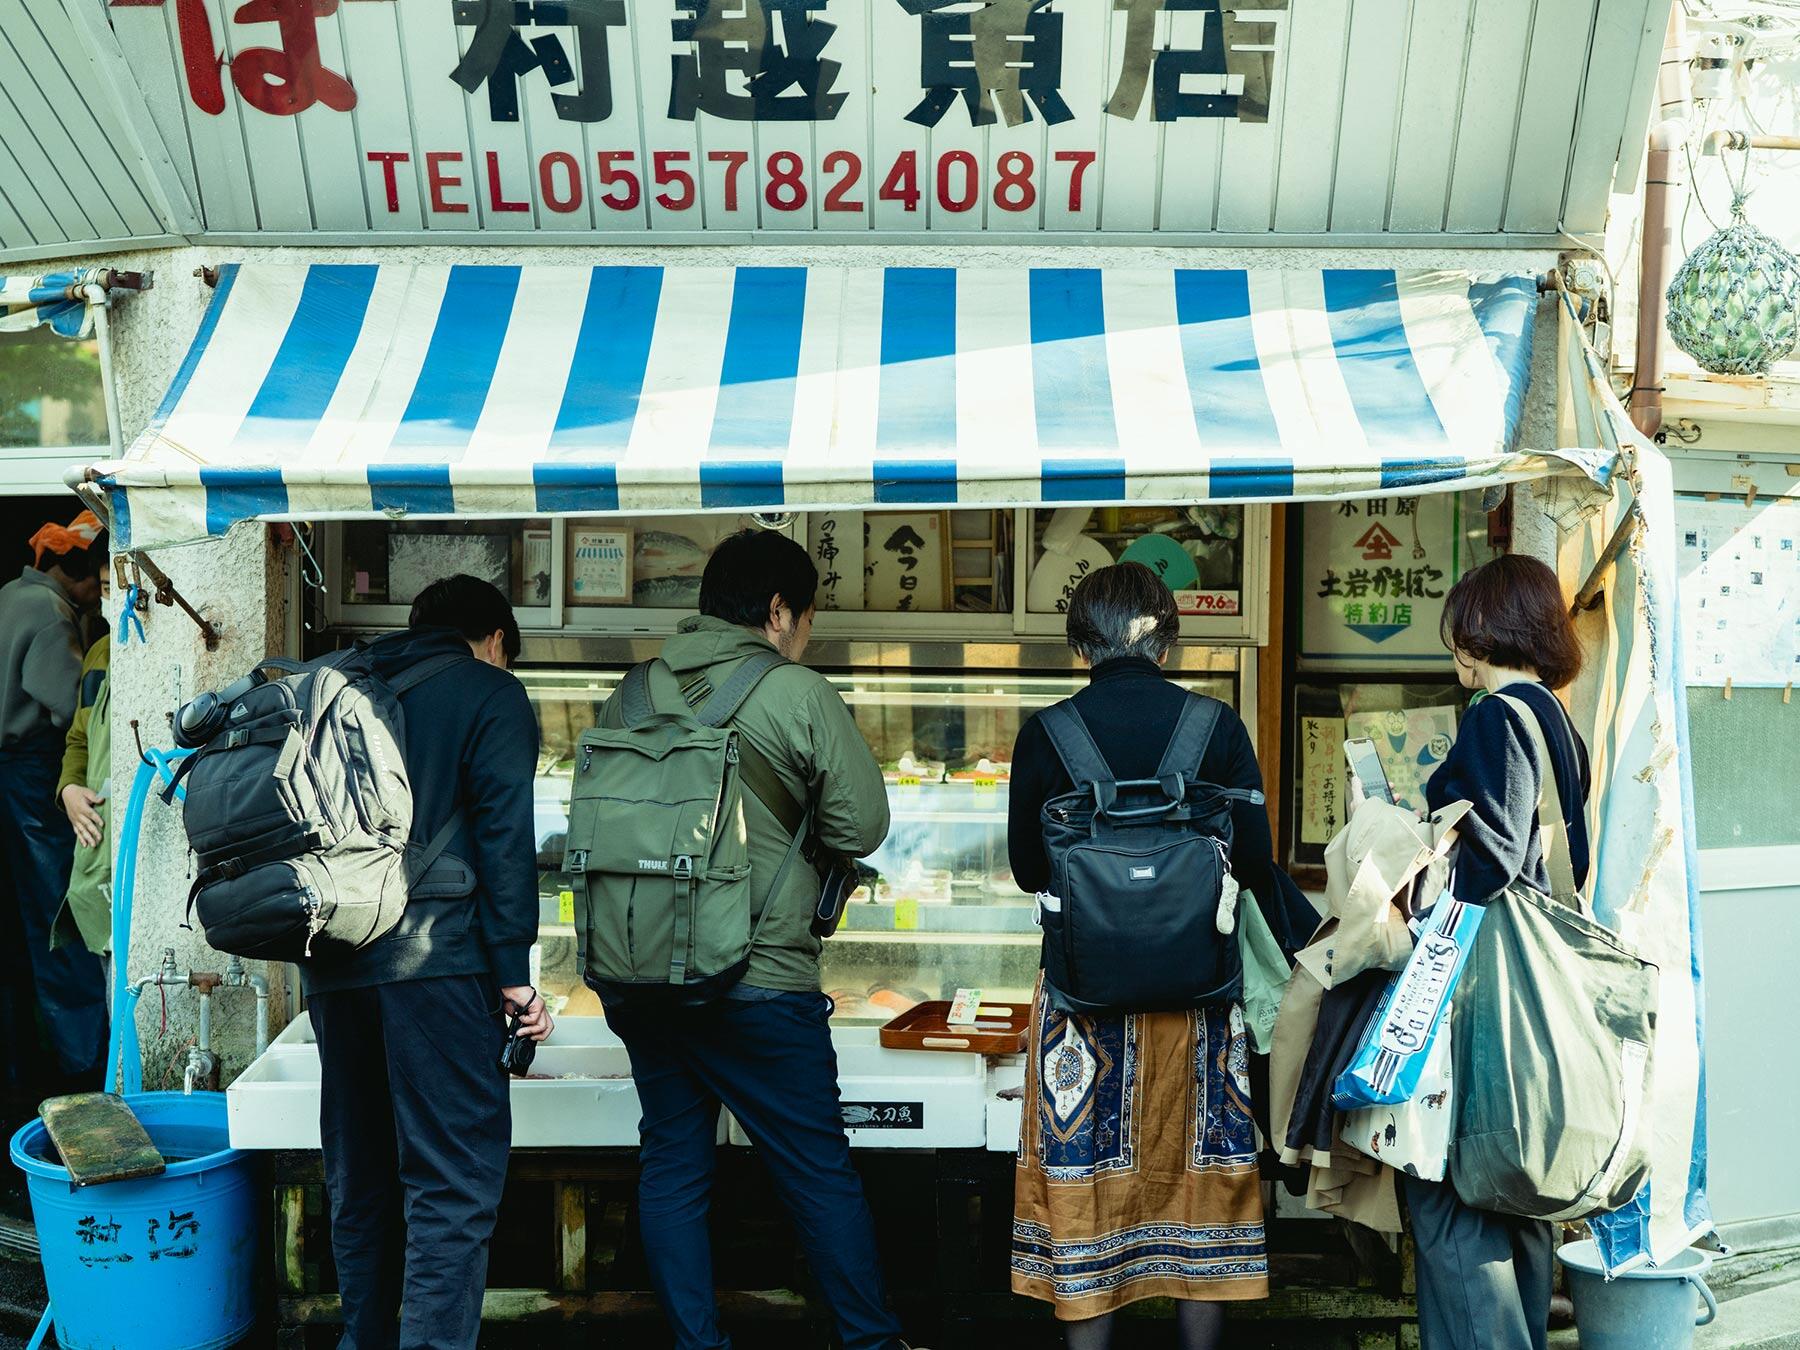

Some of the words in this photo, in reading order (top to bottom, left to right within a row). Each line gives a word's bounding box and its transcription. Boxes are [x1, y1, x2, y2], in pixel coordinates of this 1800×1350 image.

[817, 510, 842, 610] の痛みに
[1196, 595, 1226, 609] 79.6
[1344, 603, 1412, 624] 特約店
[638, 859, 668, 870] THULE
[1397, 942, 1454, 1048] SHISEIDO
[867, 1106, 912, 1123] 太刀魚
